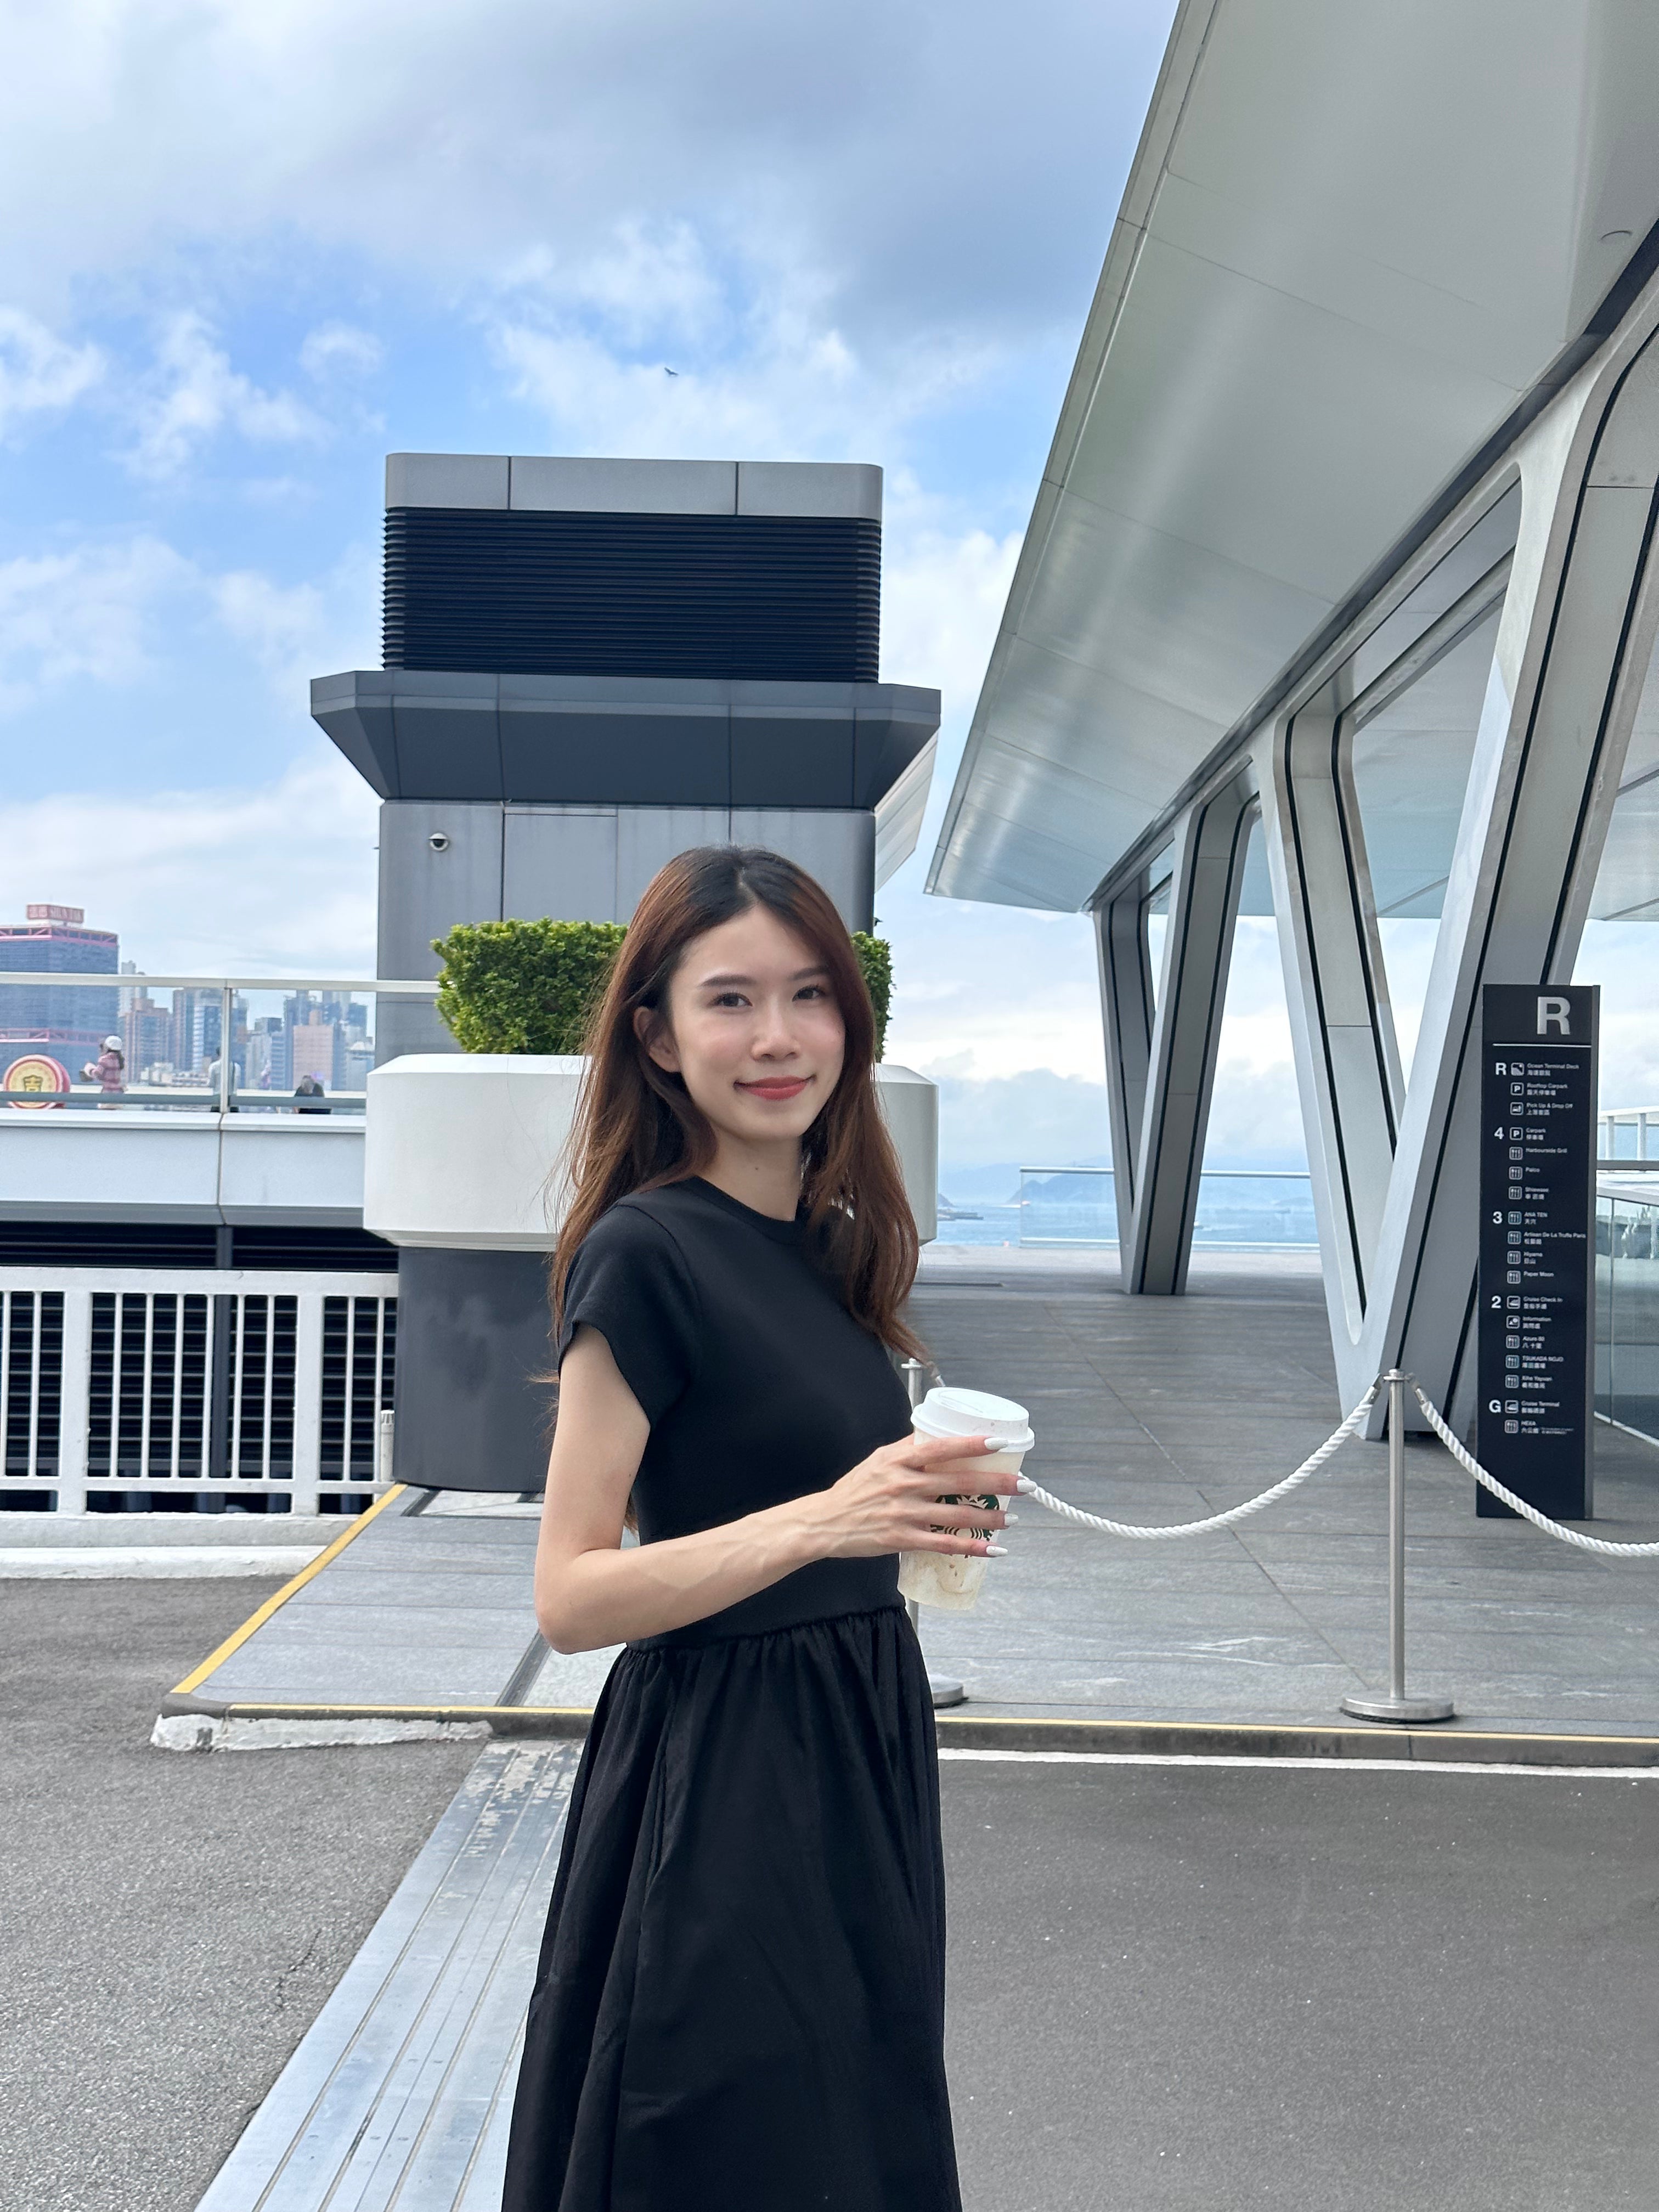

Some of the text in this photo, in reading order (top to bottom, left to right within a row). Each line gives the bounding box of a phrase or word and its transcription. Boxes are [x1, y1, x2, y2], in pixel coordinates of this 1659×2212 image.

[1537, 996, 1571, 1035] R
[1496, 1062, 1507, 1076] R
[1494, 1127, 1504, 1139] 4
[1492, 1211, 1503, 1224] 3
[1491, 1295, 1502, 1308] 2
[1489, 1400, 1502, 1413] G
